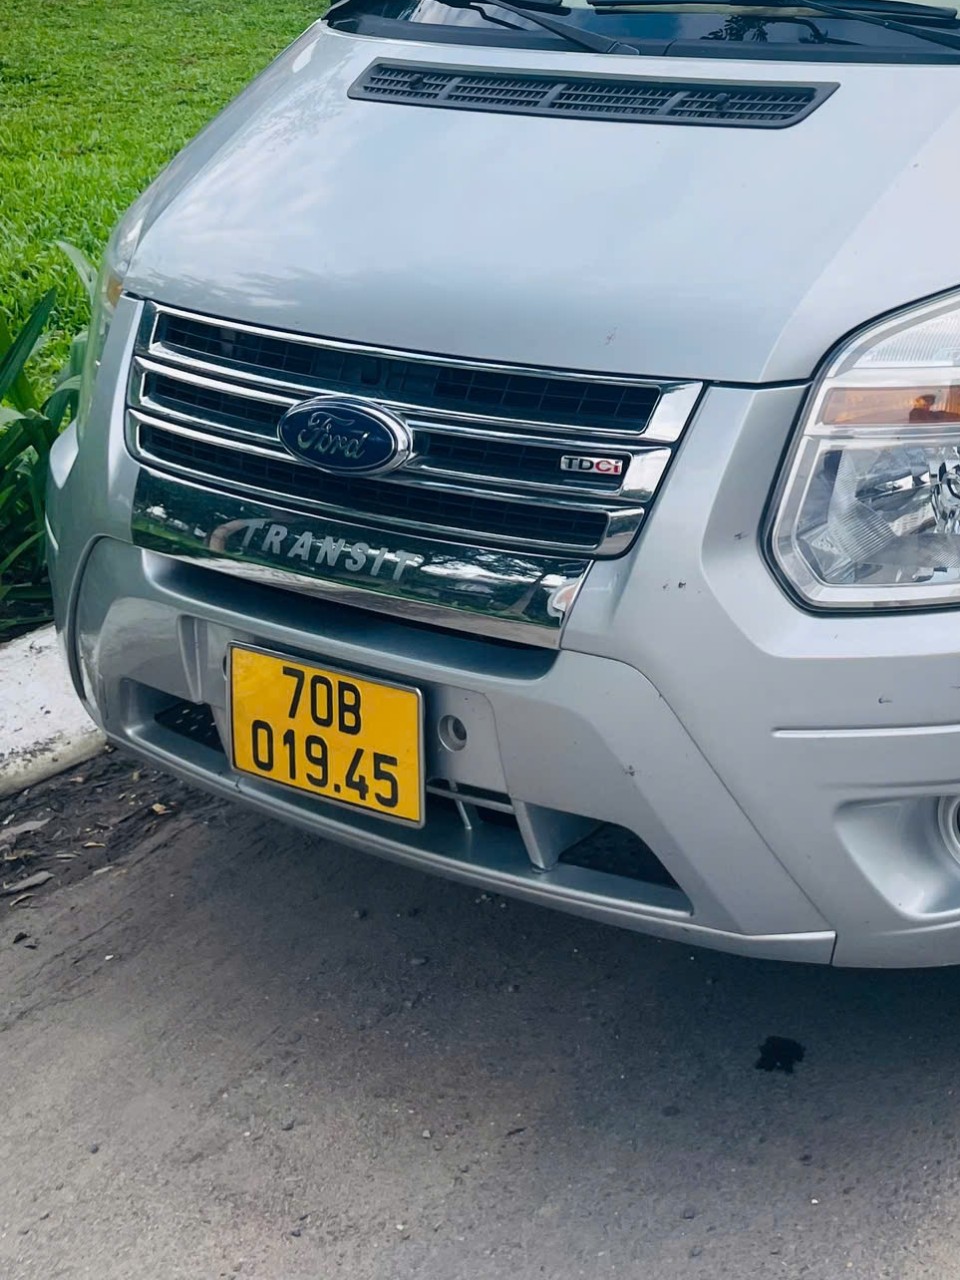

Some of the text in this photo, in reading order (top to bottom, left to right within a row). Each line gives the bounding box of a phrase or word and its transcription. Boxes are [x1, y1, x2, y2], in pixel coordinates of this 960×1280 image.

[297, 411, 370, 460] Ford
[563, 456, 622, 474] TDCi
[241, 519, 425, 581] TRANSIT
[282, 665, 362, 736] 70B
[251, 719, 399, 808] 019.45
